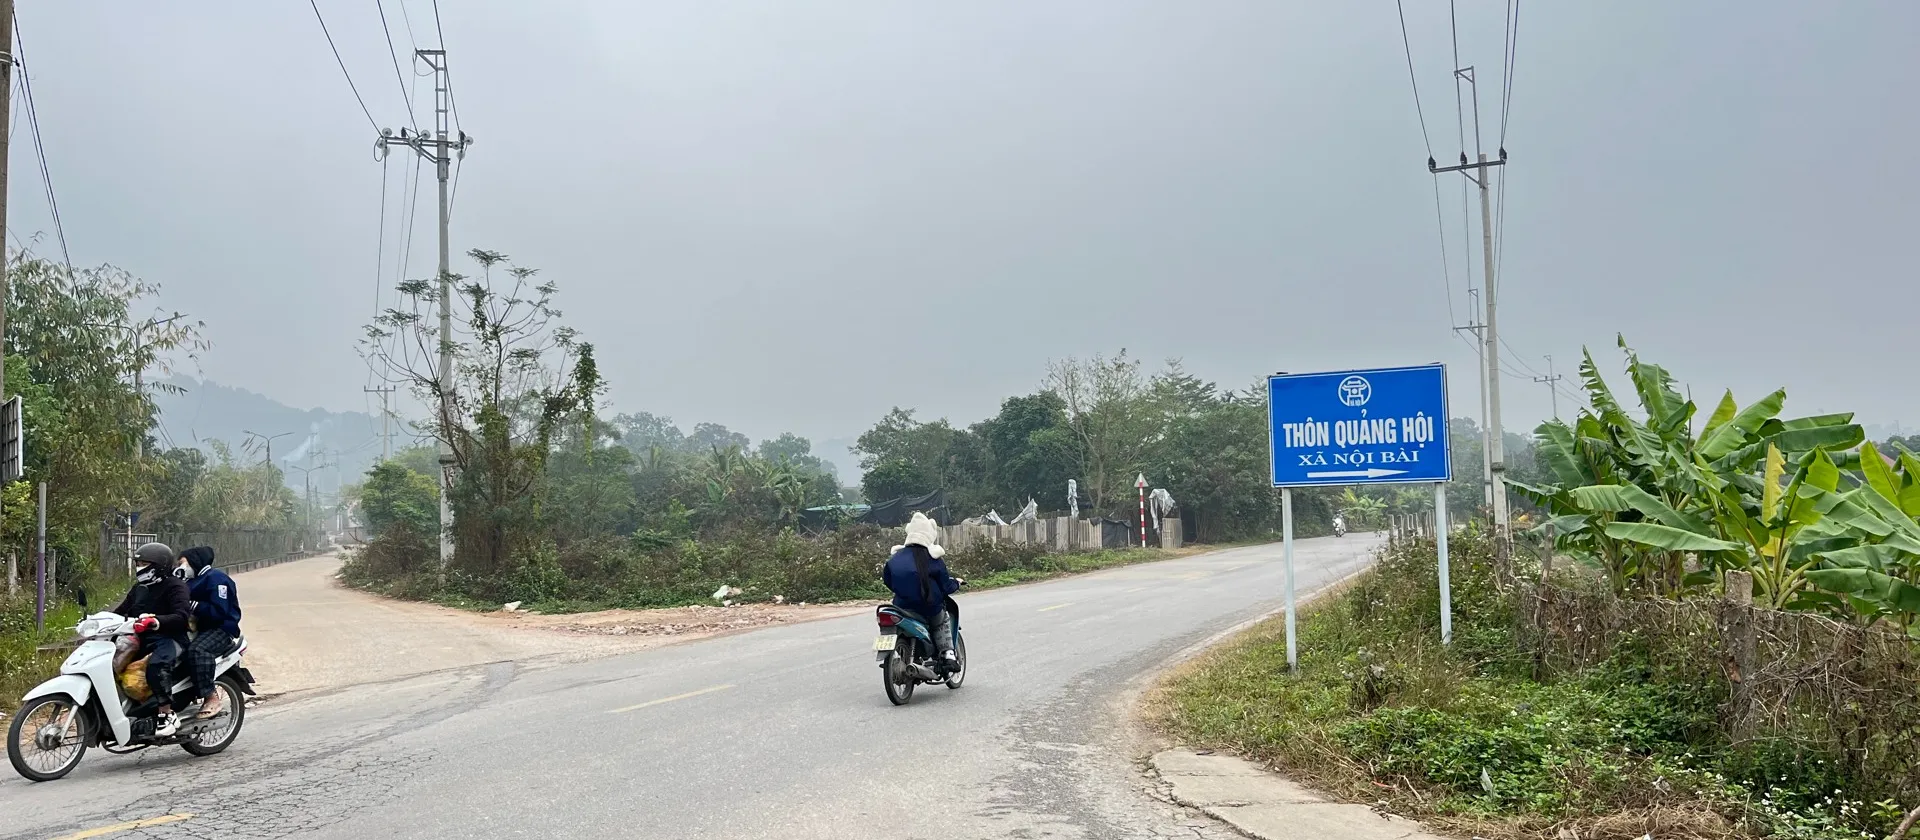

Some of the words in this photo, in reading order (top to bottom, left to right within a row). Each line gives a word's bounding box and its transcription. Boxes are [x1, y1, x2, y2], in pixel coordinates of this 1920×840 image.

[1282, 416, 1329, 448] THÔN
[1335, 408, 1397, 449] QUẢNG
[1402, 411, 1434, 448] HỘI
[1298, 451, 1328, 466] XÃ
[1333, 449, 1375, 467] NỘI
[1380, 447, 1420, 463] BÀI
